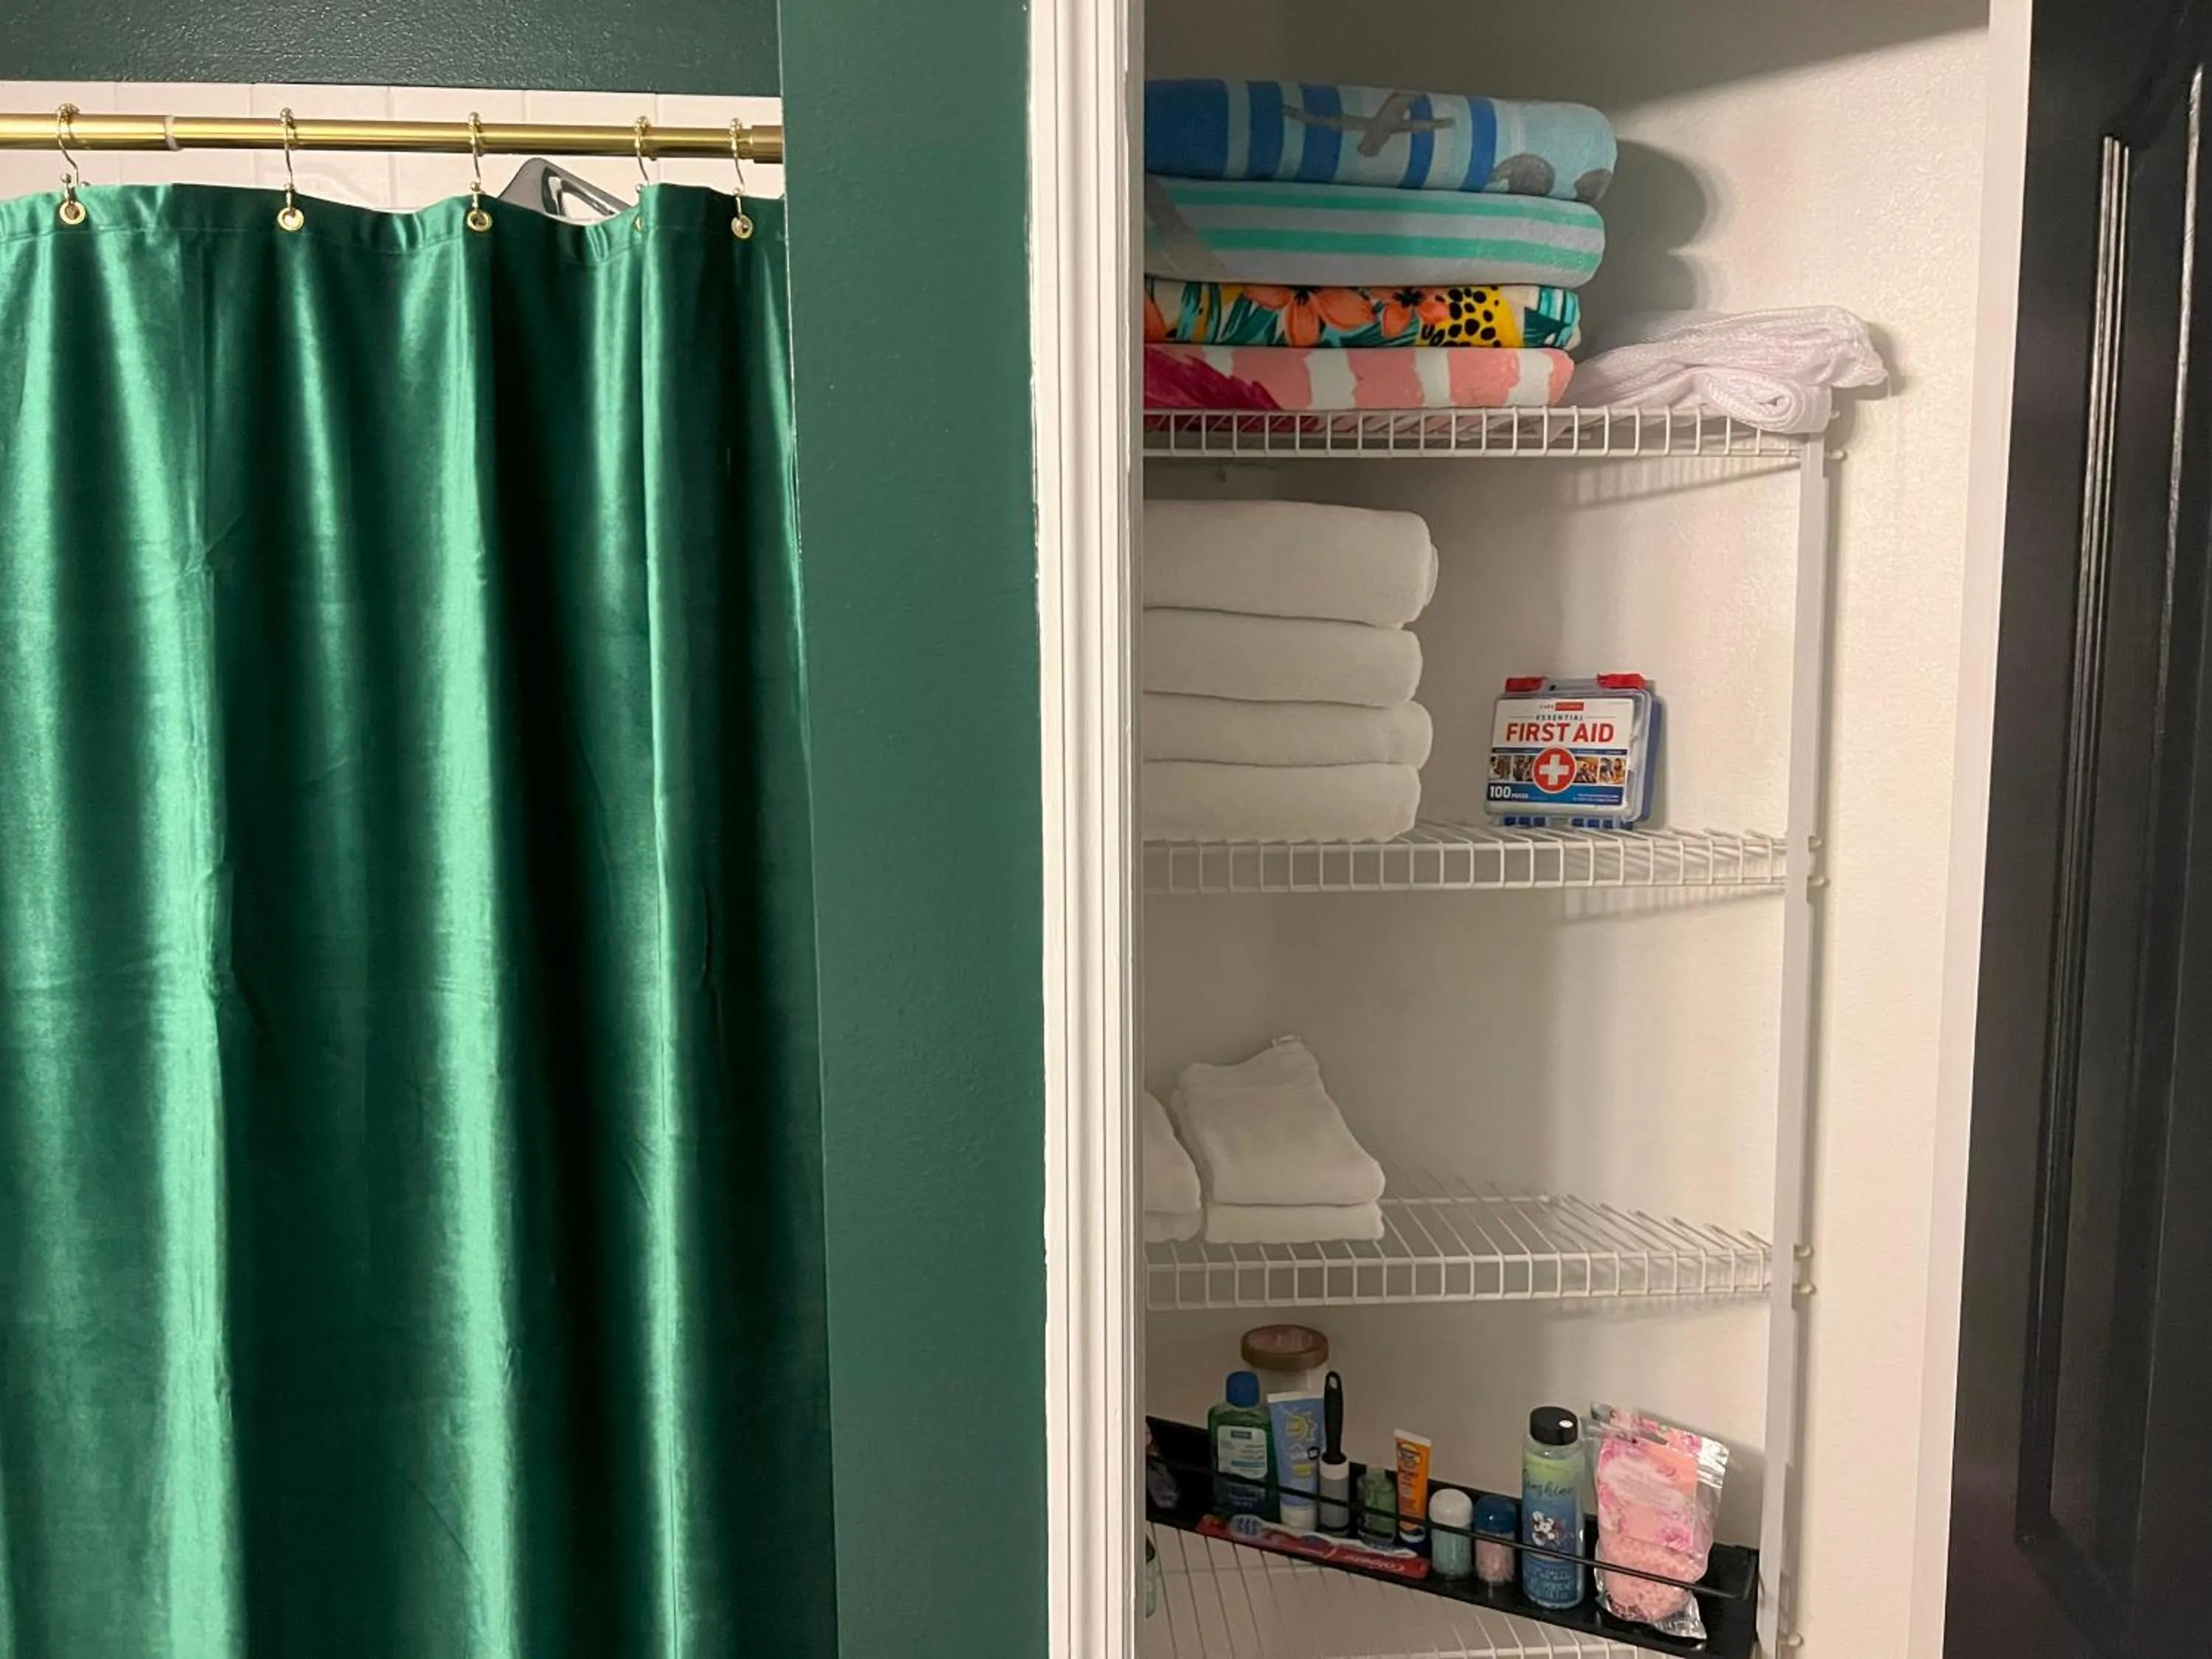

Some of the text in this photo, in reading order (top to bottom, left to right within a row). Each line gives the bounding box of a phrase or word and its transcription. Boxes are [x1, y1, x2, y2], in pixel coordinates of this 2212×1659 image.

[1506, 723, 1614, 743] FIRST AID
[1489, 785, 1511, 799] 100
